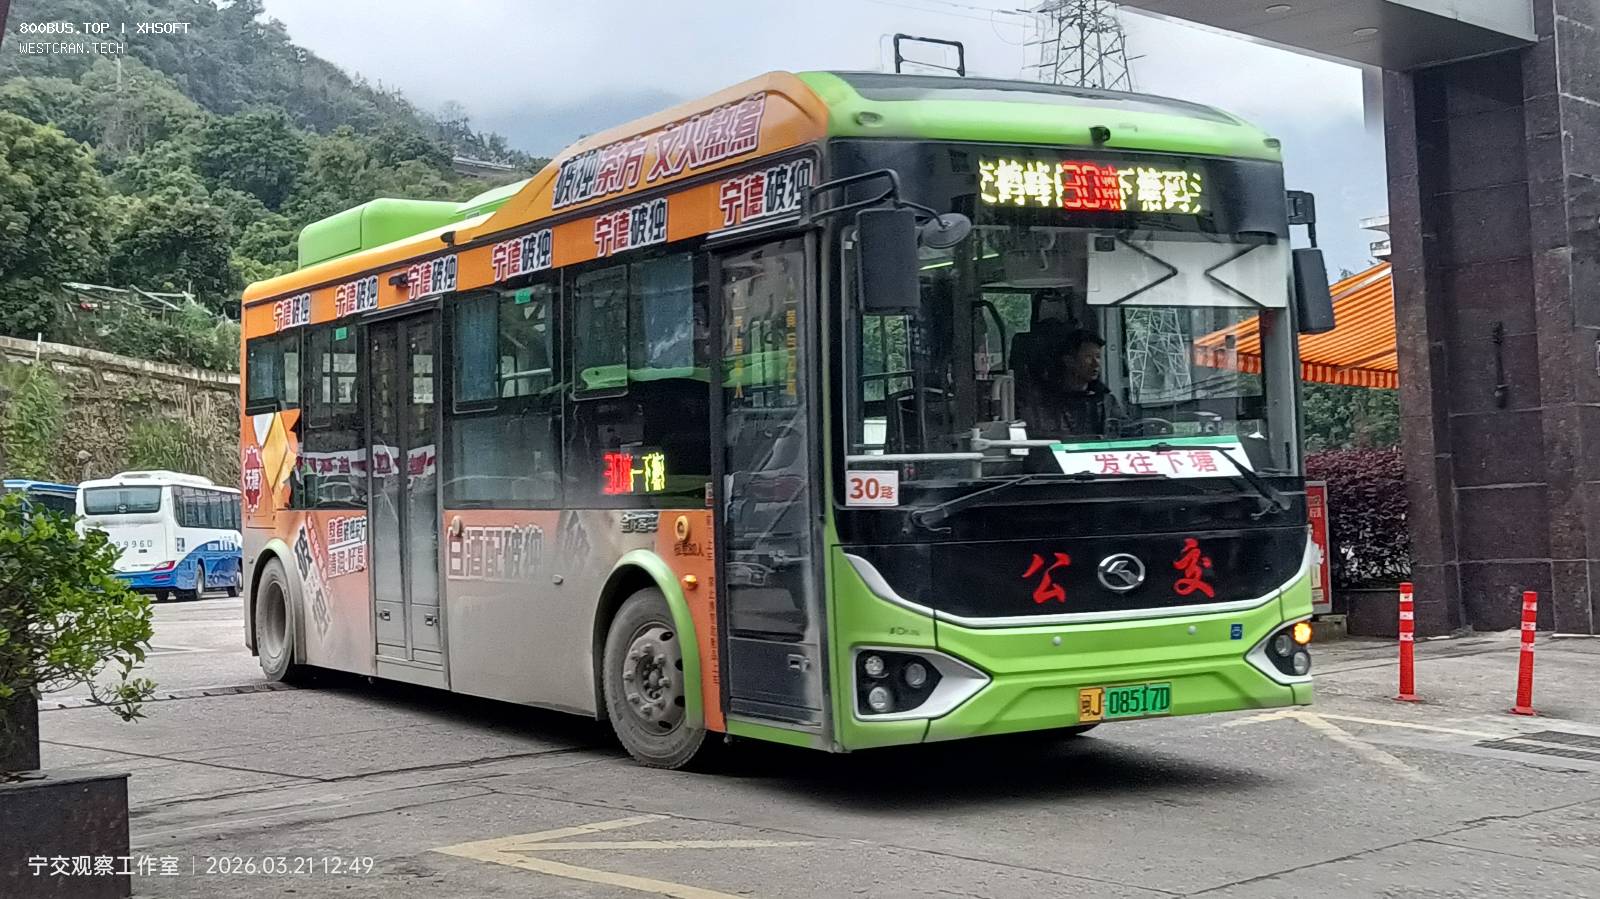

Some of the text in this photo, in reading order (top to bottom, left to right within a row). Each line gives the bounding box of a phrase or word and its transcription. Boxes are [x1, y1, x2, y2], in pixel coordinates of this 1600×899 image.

[1094, 450, 1218, 474] 发往下塘
[1021, 537, 1216, 604] 公 交
[1109, 686, 1170, 715] 08517D
